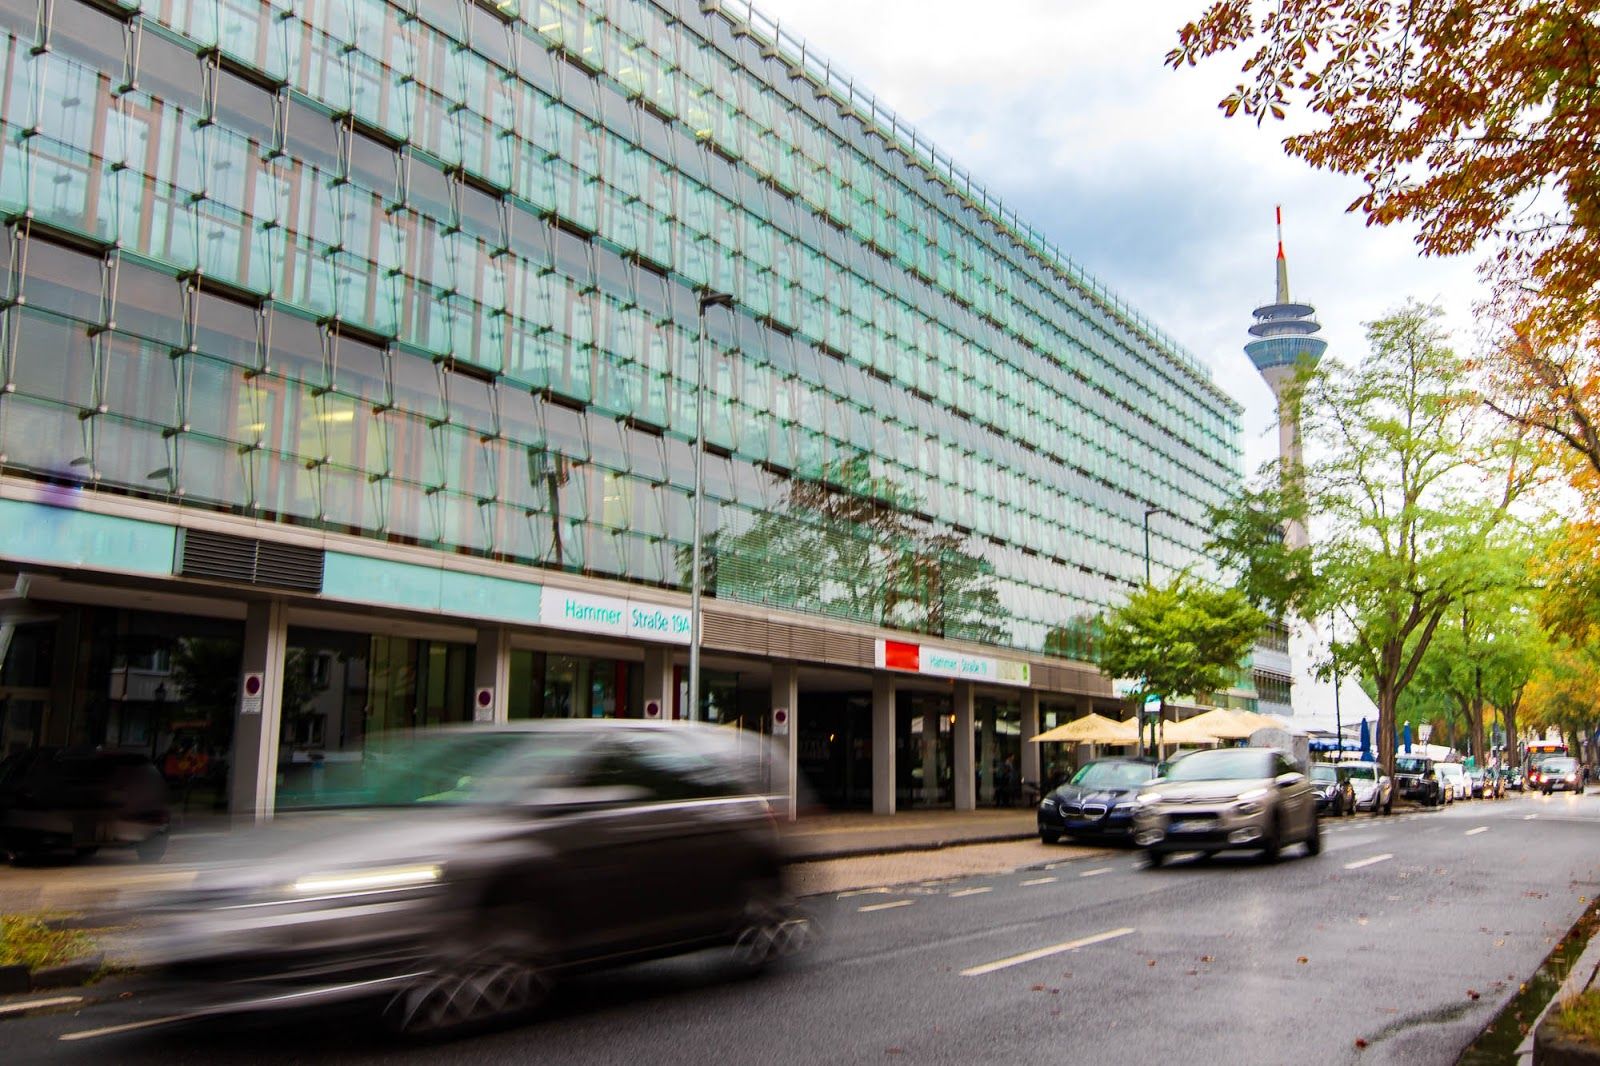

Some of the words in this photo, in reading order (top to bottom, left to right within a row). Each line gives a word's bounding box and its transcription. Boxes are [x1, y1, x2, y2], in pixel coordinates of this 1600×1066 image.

[565, 599, 622, 625] Hammer
[631, 608, 669, 632] Straße
[671, 615, 690, 633] 19A
